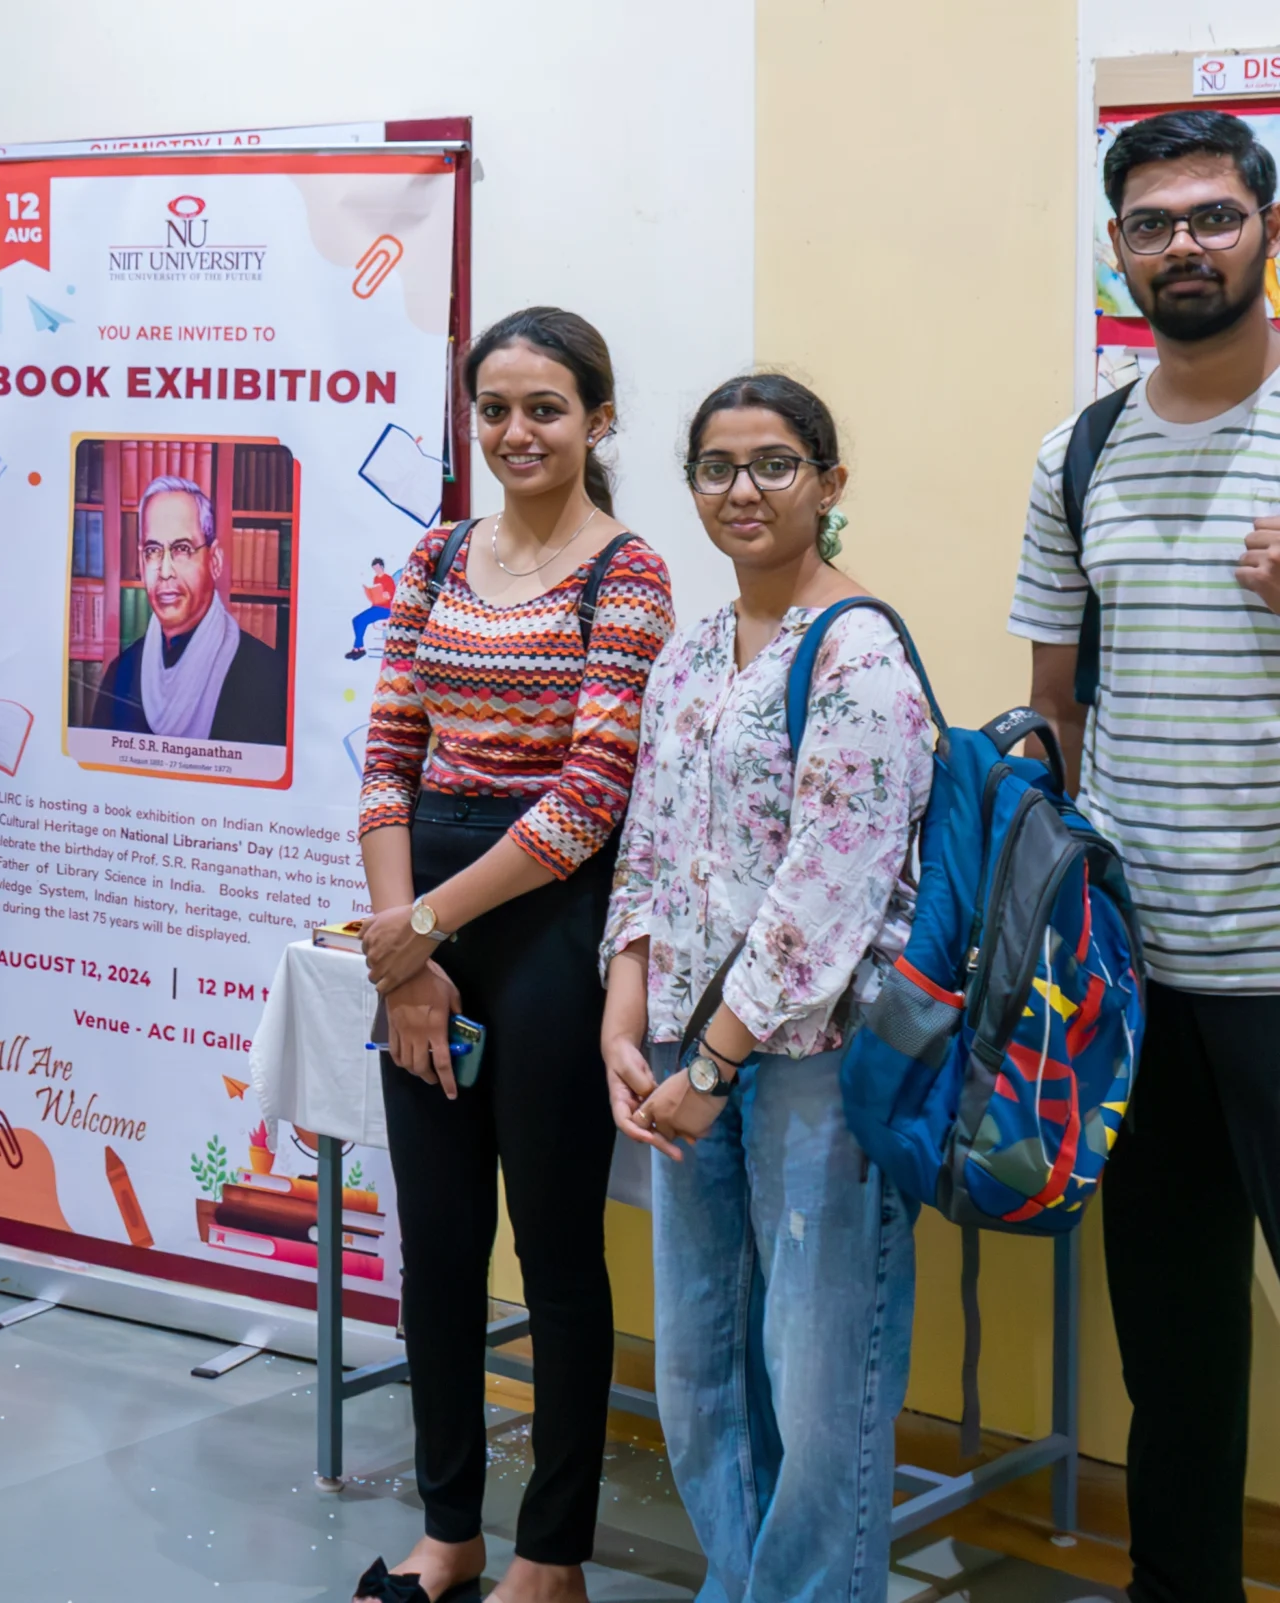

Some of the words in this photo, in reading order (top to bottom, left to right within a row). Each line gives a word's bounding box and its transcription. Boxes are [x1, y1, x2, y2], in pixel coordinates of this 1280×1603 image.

[1200, 74, 1226, 91] NU
[1244, 57, 1280, 79] DIS
[6, 193, 40, 220] 12
[4, 227, 43, 243] AUG
[165, 219, 209, 248] NU
[109, 252, 143, 271] NIIT
[150, 251, 266, 271] UNIVERSITY
[109, 273, 126, 281] THE
[128, 273, 187, 281] UNIVERSITY
[189, 273, 202, 281] OF
[204, 273, 222, 281] THE
[225, 273, 263, 281] FUTURE
[97, 326, 130, 340] YOU
[136, 326, 173, 340] ARE
[178, 326, 248, 341] INVITED
[252, 327, 276, 342] TO
[127, 367, 396, 405] EXHIBITION
[111, 736, 136, 749] Prof.
[138, 740, 159, 752] S.R.
[162, 741, 243, 760] Ranganathan
[26, 795, 34, 808] is
[39, 797, 87, 815] hosting
[93, 804, 99, 814] a
[105, 803, 132, 818] book
[136, 809, 195, 825] exhibition
[201, 817, 217, 827] on
[223, 817, 263, 833] Indian
[270, 821, 341, 843] Knowledge
[0, 813, 40, 830] Cultural
[44, 819, 99, 837] Heritage
[102, 827, 116, 838] on
[120, 827, 169, 845] National
[173, 833, 242, 853] Librarians'
[247, 841, 273, 858] Day
[279, 845, 299, 860] (12
[304, 848, 350, 866] August
[40, 840, 60, 854] the
[65, 842, 114, 862] birthday
[117, 849, 128, 861] of
[131, 851, 159, 867] Prof.
[162, 855, 187, 869] S.R.
[191, 858, 281, 881] Ranganathan,
[285, 871, 313, 884] who
[316, 875, 326, 886] is
[36, 863, 50, 874] of
[56, 863, 99, 881] Library
[104, 869, 147, 887] Science
[152, 876, 163, 889] in
[170, 878, 205, 894] India.
[219, 884, 259, 900] Books
[266, 891, 311, 906] related
[318, 898, 331, 909] to
[2, 900, 41, 919] during
[44, 906, 65, 918] the
[69, 908, 89, 922] last
[93, 911, 107, 925] 75
[109, 916, 139, 930] years
[142, 919, 163, 932] will
[167, 924, 182, 935] be
[186, 925, 251, 944] displayed.
[39, 883, 89, 901] System,
[94, 890, 128, 906] Indian
[134, 896, 178, 915] history,
[185, 902, 241, 923] heritage,
[248, 912, 297, 928] culture,
[80, 960, 102, 981] 12,
[108, 964, 151, 987] 2024
[197, 977, 217, 996] 12
[224, 981, 254, 1001] PM
[74, 1009, 130, 1034] Venue
[148, 1022, 176, 1041] AC
[183, 1027, 195, 1044] II
[28, 1046, 73, 1081] Are
[35, 1086, 147, 1141] Welcome
